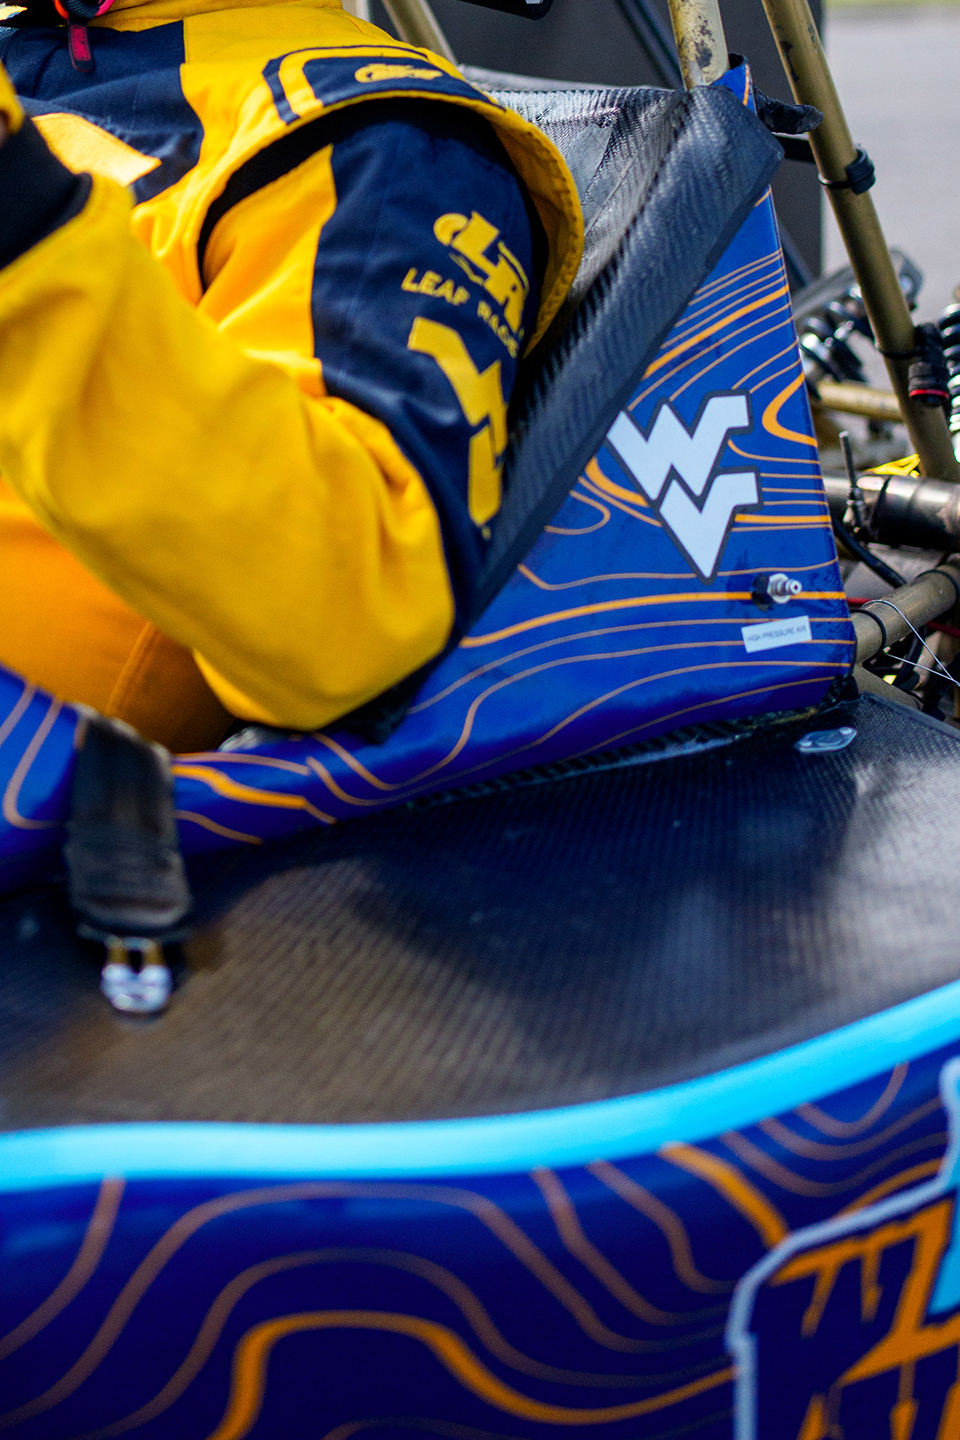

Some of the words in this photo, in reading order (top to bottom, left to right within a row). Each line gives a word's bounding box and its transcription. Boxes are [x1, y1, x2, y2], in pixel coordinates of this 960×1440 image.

[401, 267, 470, 306] LEAF
[762, 626, 795, 639] PRESSURE
[796, 624, 807, 633] AIR
